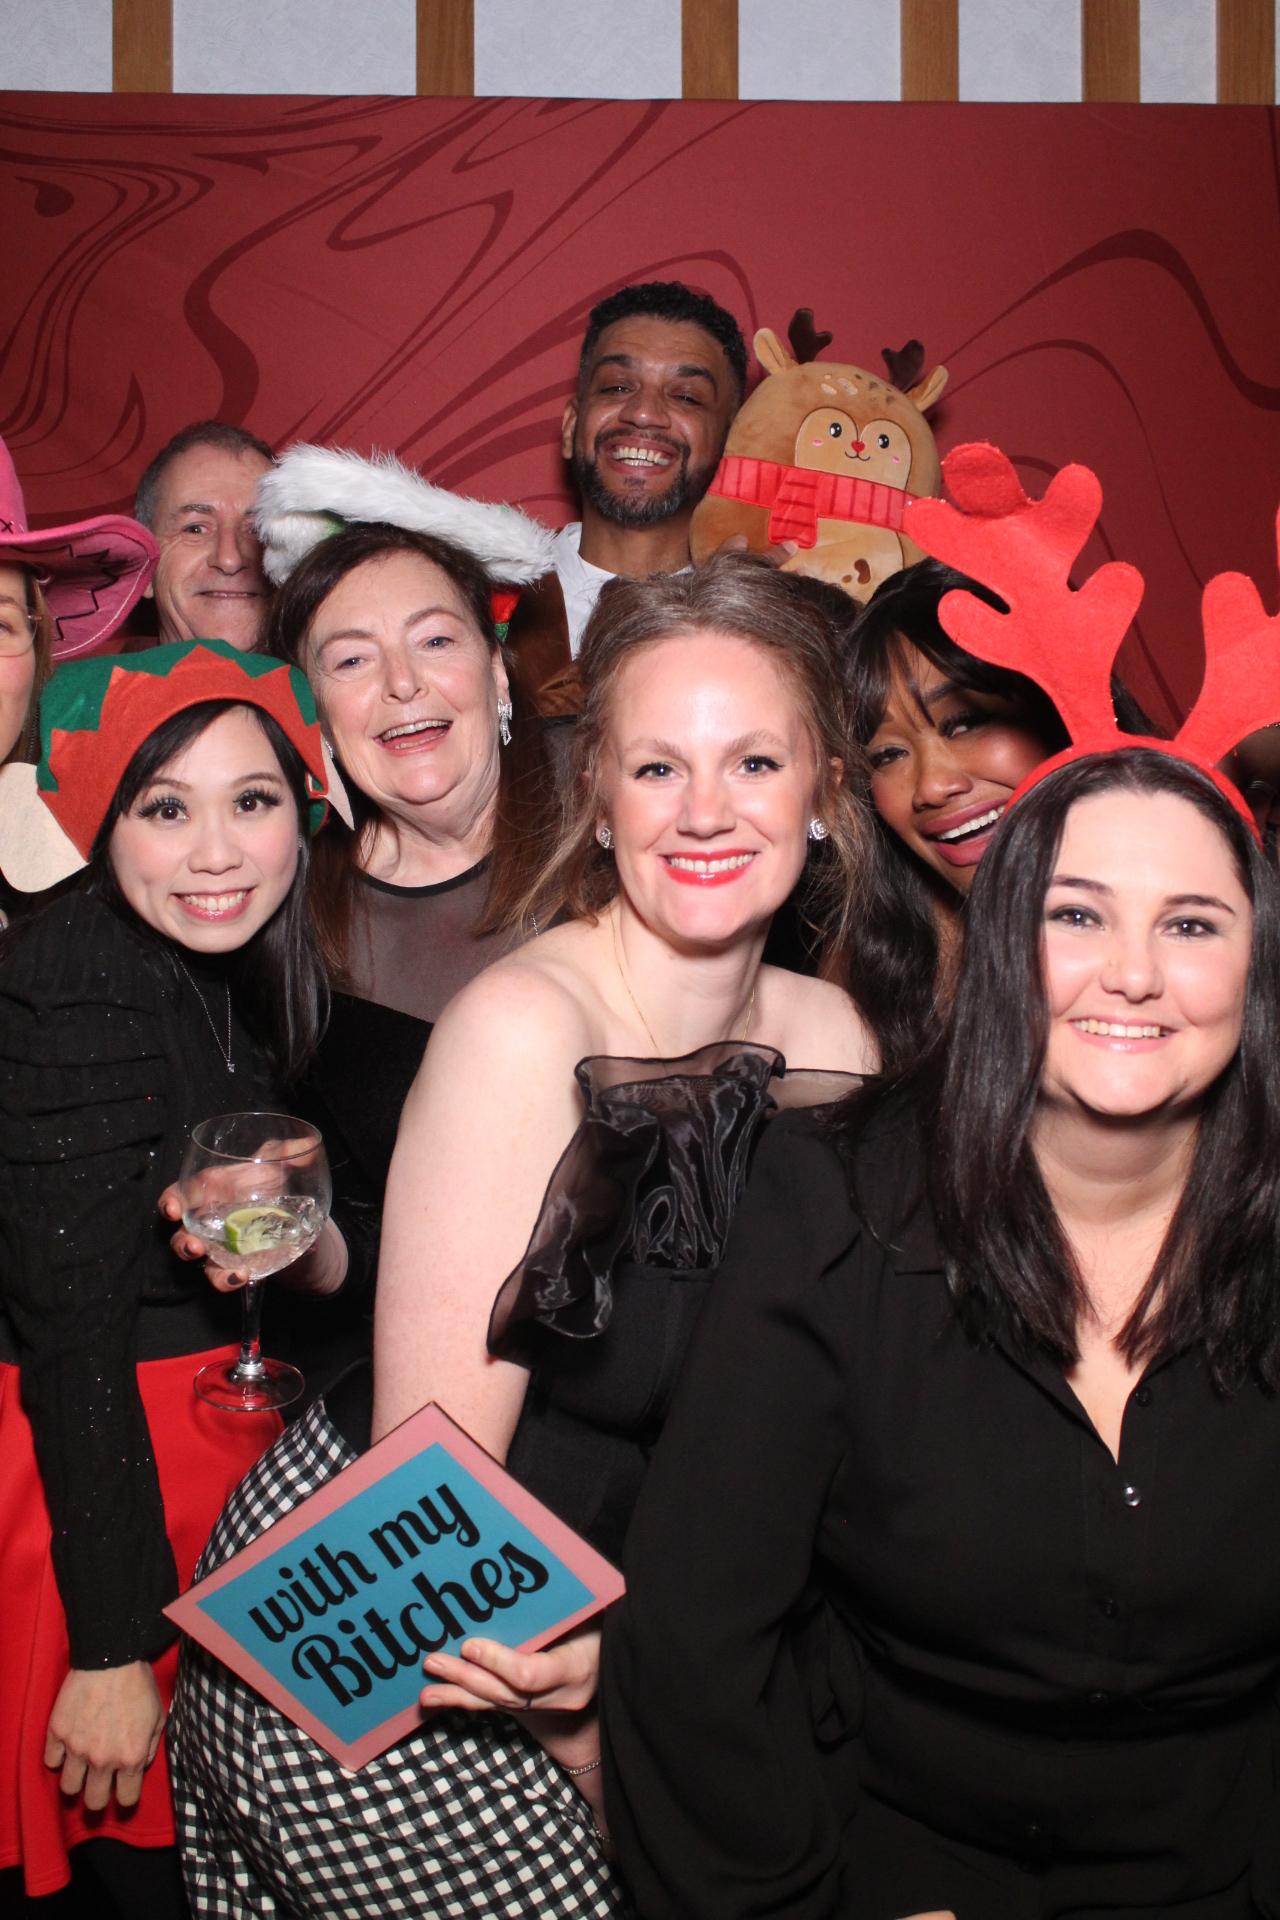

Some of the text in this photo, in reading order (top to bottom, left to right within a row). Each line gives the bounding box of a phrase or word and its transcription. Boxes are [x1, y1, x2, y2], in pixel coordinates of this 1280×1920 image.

[248, 1483, 481, 1643] with my
[291, 1541, 550, 1708] Bitches
